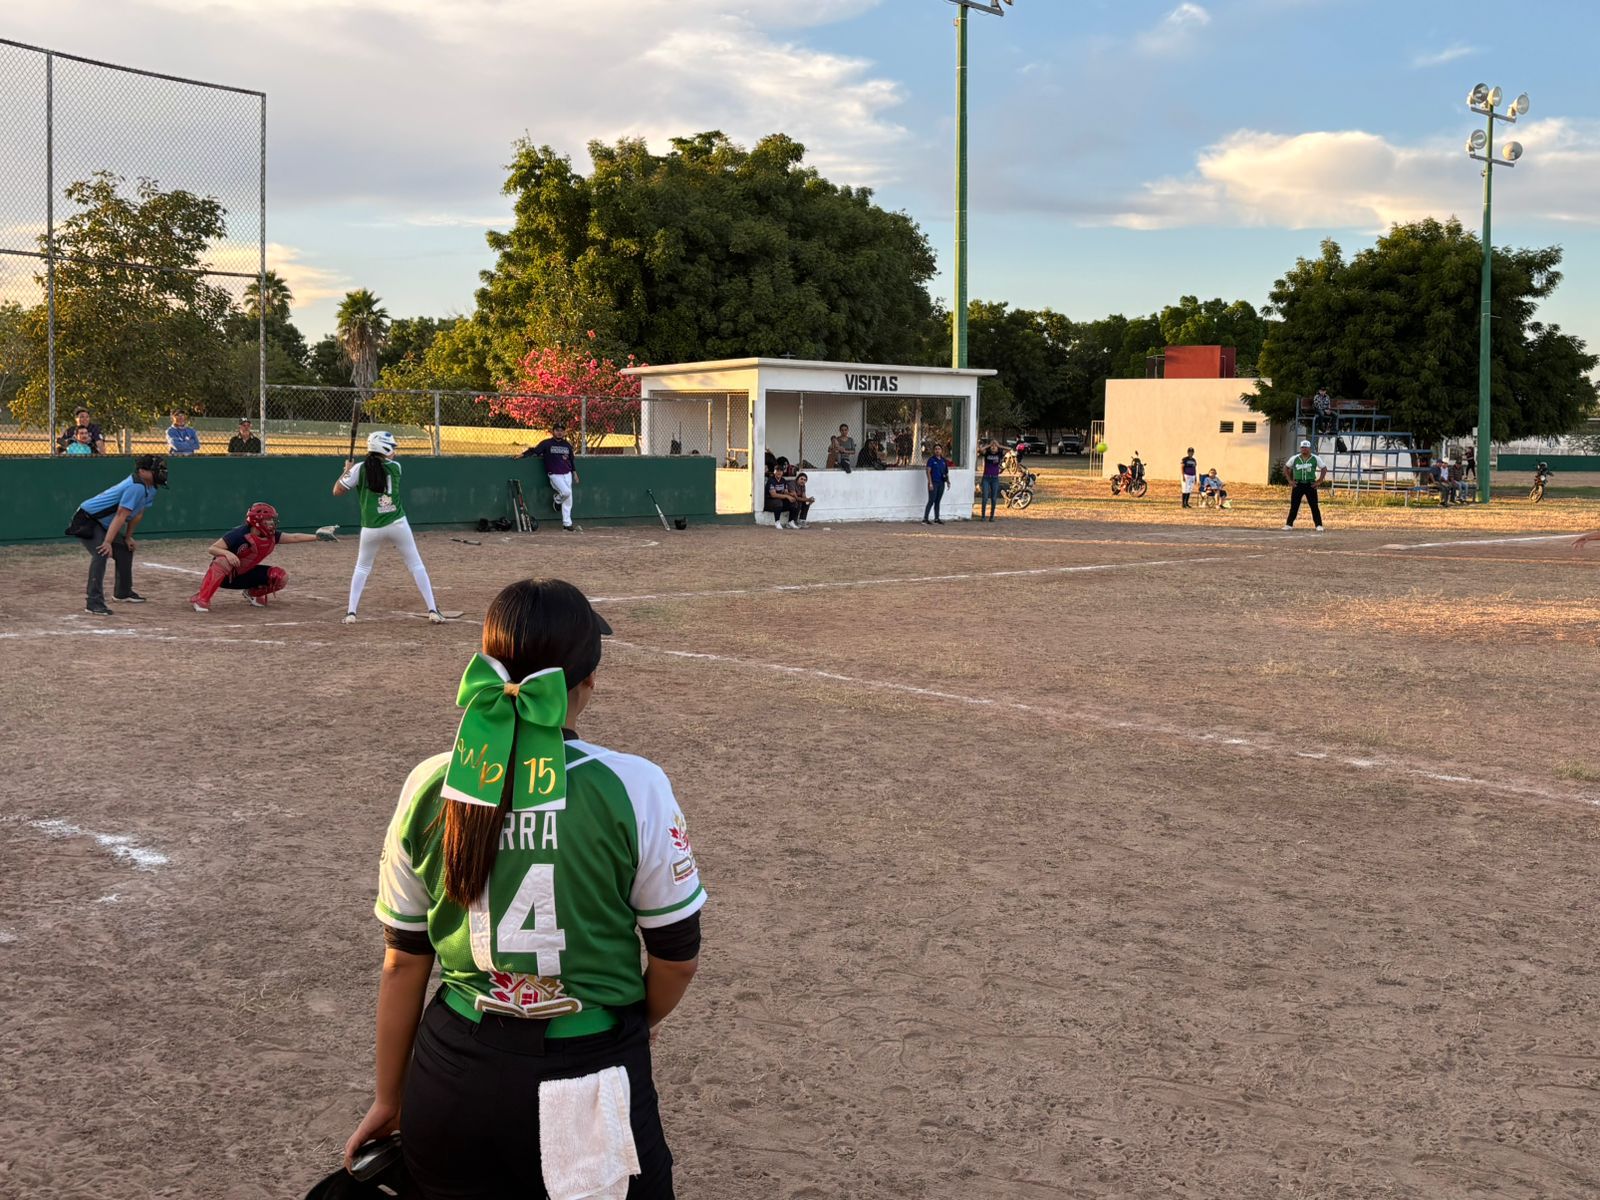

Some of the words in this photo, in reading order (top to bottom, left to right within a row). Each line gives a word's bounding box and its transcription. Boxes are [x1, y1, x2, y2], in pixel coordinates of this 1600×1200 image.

[845, 373, 898, 392] VISITAS
[523, 757, 556, 795] 15
[499, 811, 558, 850] RRA
